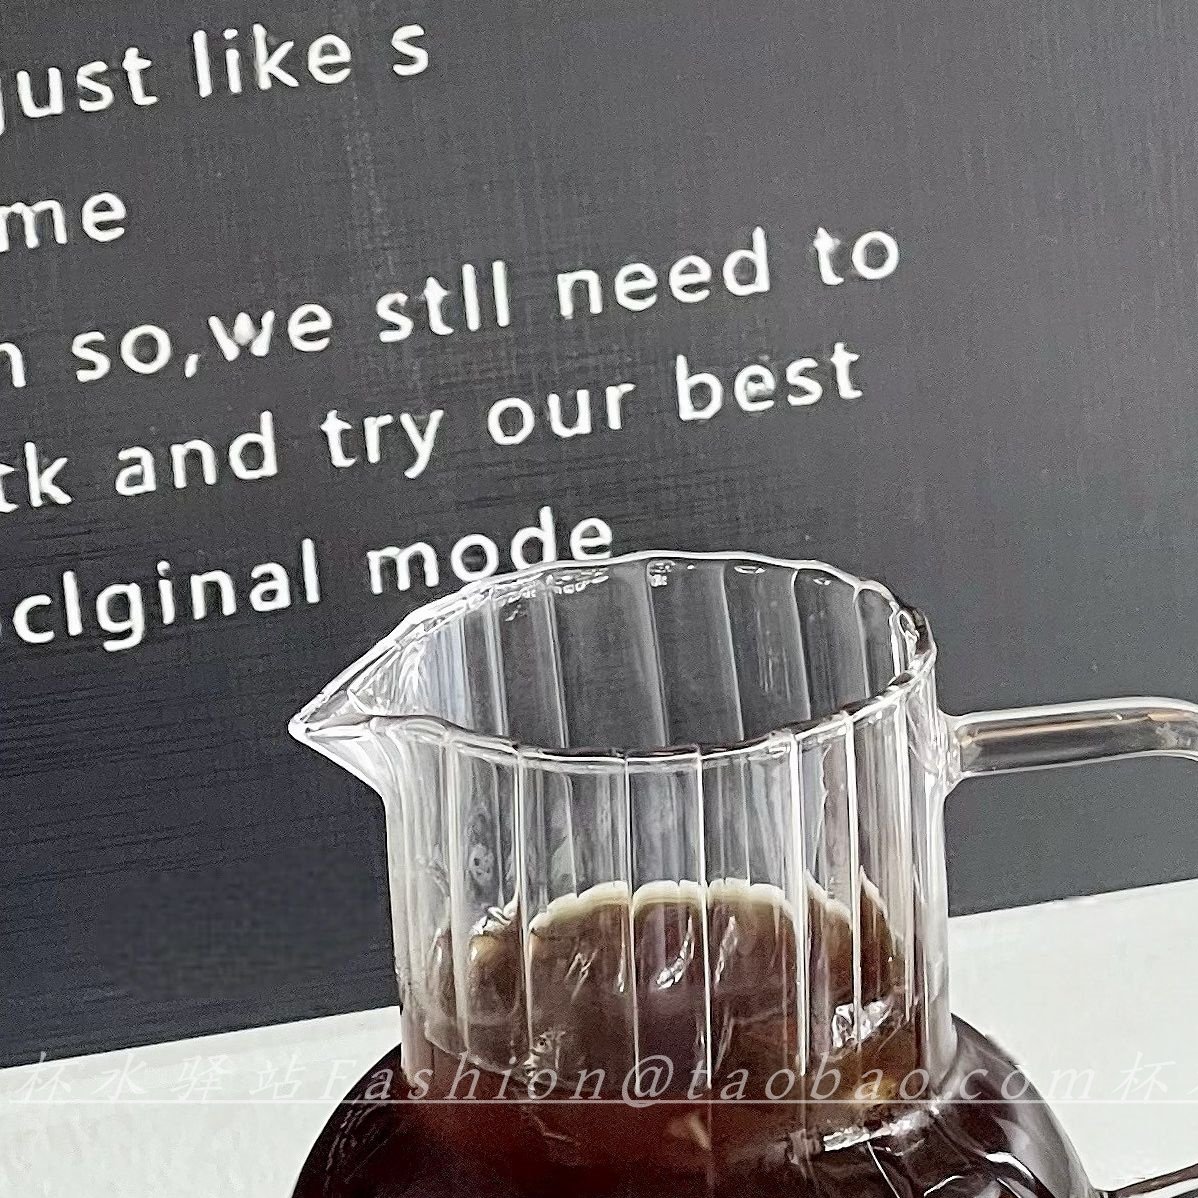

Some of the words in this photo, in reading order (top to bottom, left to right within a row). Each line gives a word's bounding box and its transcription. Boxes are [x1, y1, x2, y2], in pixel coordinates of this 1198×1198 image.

[0, 48, 158, 136] ust
[192, 23, 352, 98] like
[391, 23, 429, 76] s
[375, 260, 510, 343] stll
[556, 226, 771, 320] need
[812, 226, 900, 286] to
[115, 410, 278, 496] and
[319, 409, 444, 479] try
[487, 383, 636, 446] our
[674, 341, 863, 422] best
[366, 505, 614, 595] mode
